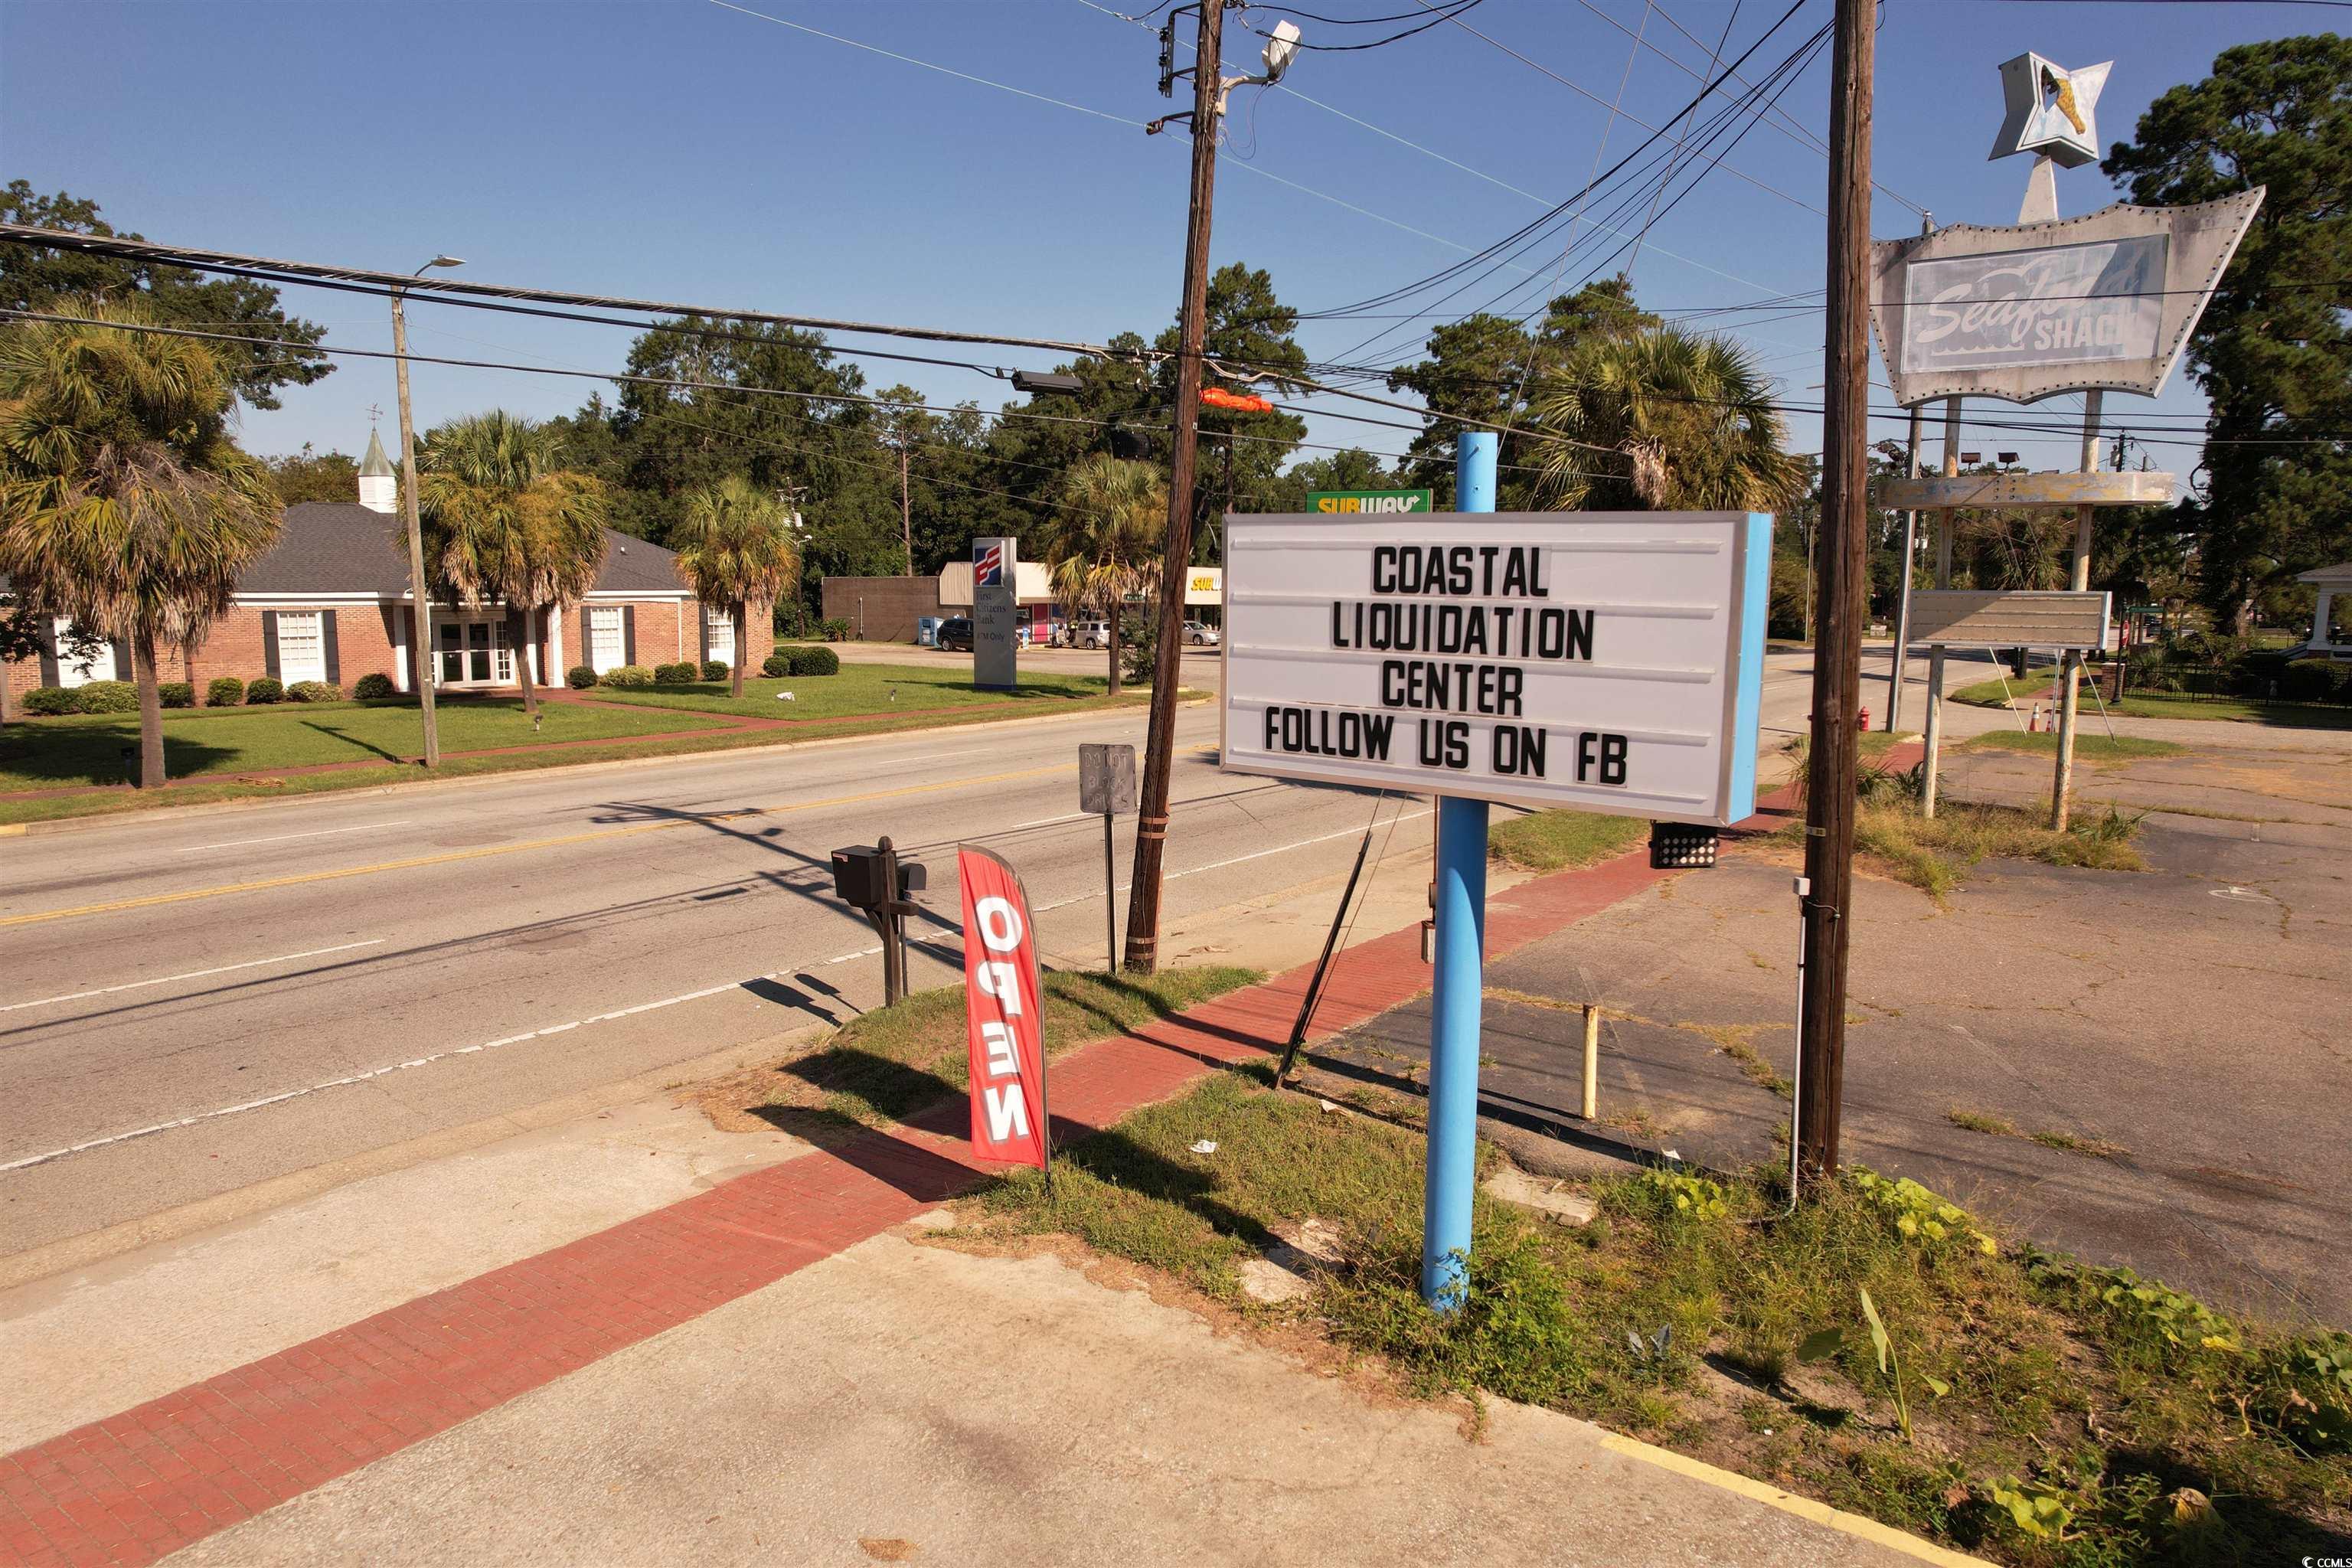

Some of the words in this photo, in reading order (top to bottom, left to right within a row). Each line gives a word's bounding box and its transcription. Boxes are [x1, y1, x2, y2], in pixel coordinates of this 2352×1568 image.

[1318, 496, 1420, 514] SUBWAY
[1373, 546, 1548, 597] COASTAL
[1333, 601, 1595, 661] LIQUIDATION
[1382, 660, 1524, 717] CENTER
[1105, 753, 1129, 769] NOT
[1266, 706, 1395, 761] FOLLOW
[1419, 718, 1469, 769] US
[1493, 724, 1547, 777] ON
[1577, 731, 1628, 786] FB
